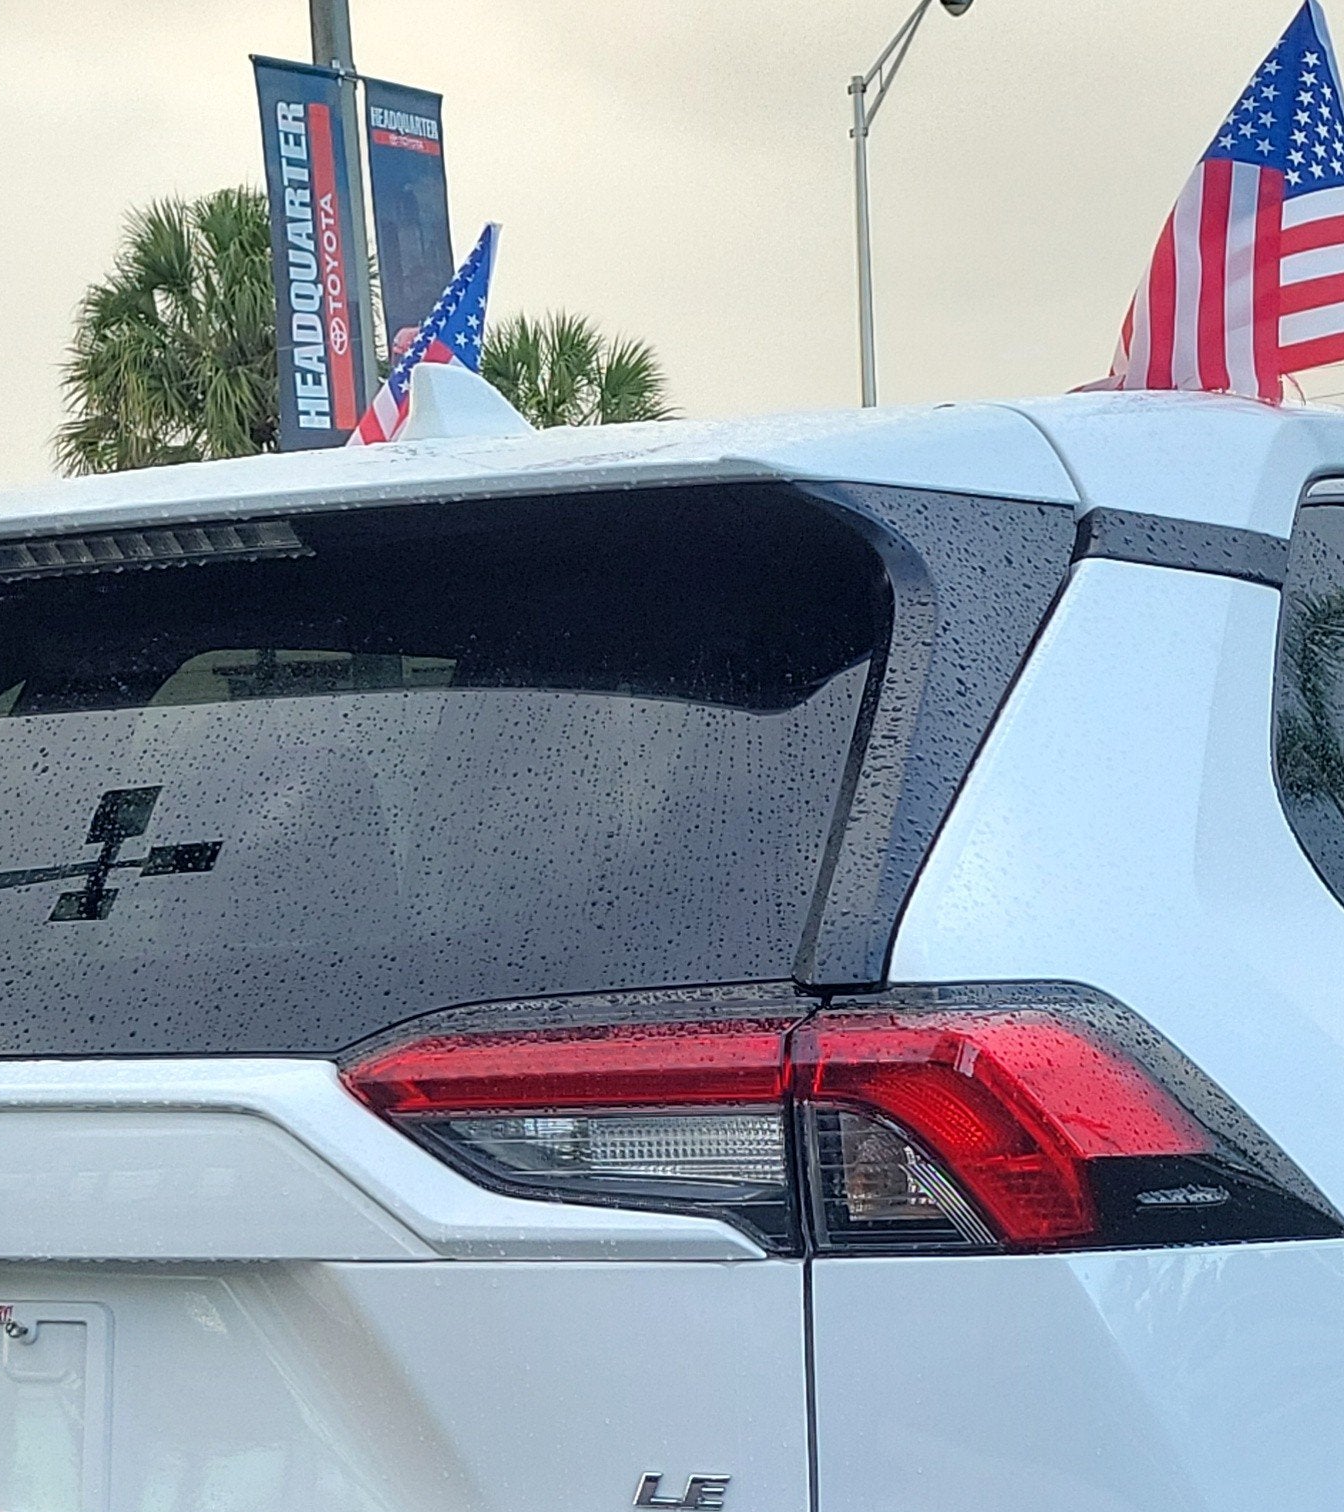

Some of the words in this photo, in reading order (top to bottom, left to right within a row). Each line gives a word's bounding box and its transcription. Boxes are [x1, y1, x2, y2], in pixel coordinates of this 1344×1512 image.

[370, 106, 439, 140] HEADQUARTER
[277, 102, 331, 430] HEADQUARTER
[319, 193, 344, 314] TOYOTA
[633, 1472, 732, 1511] LE
